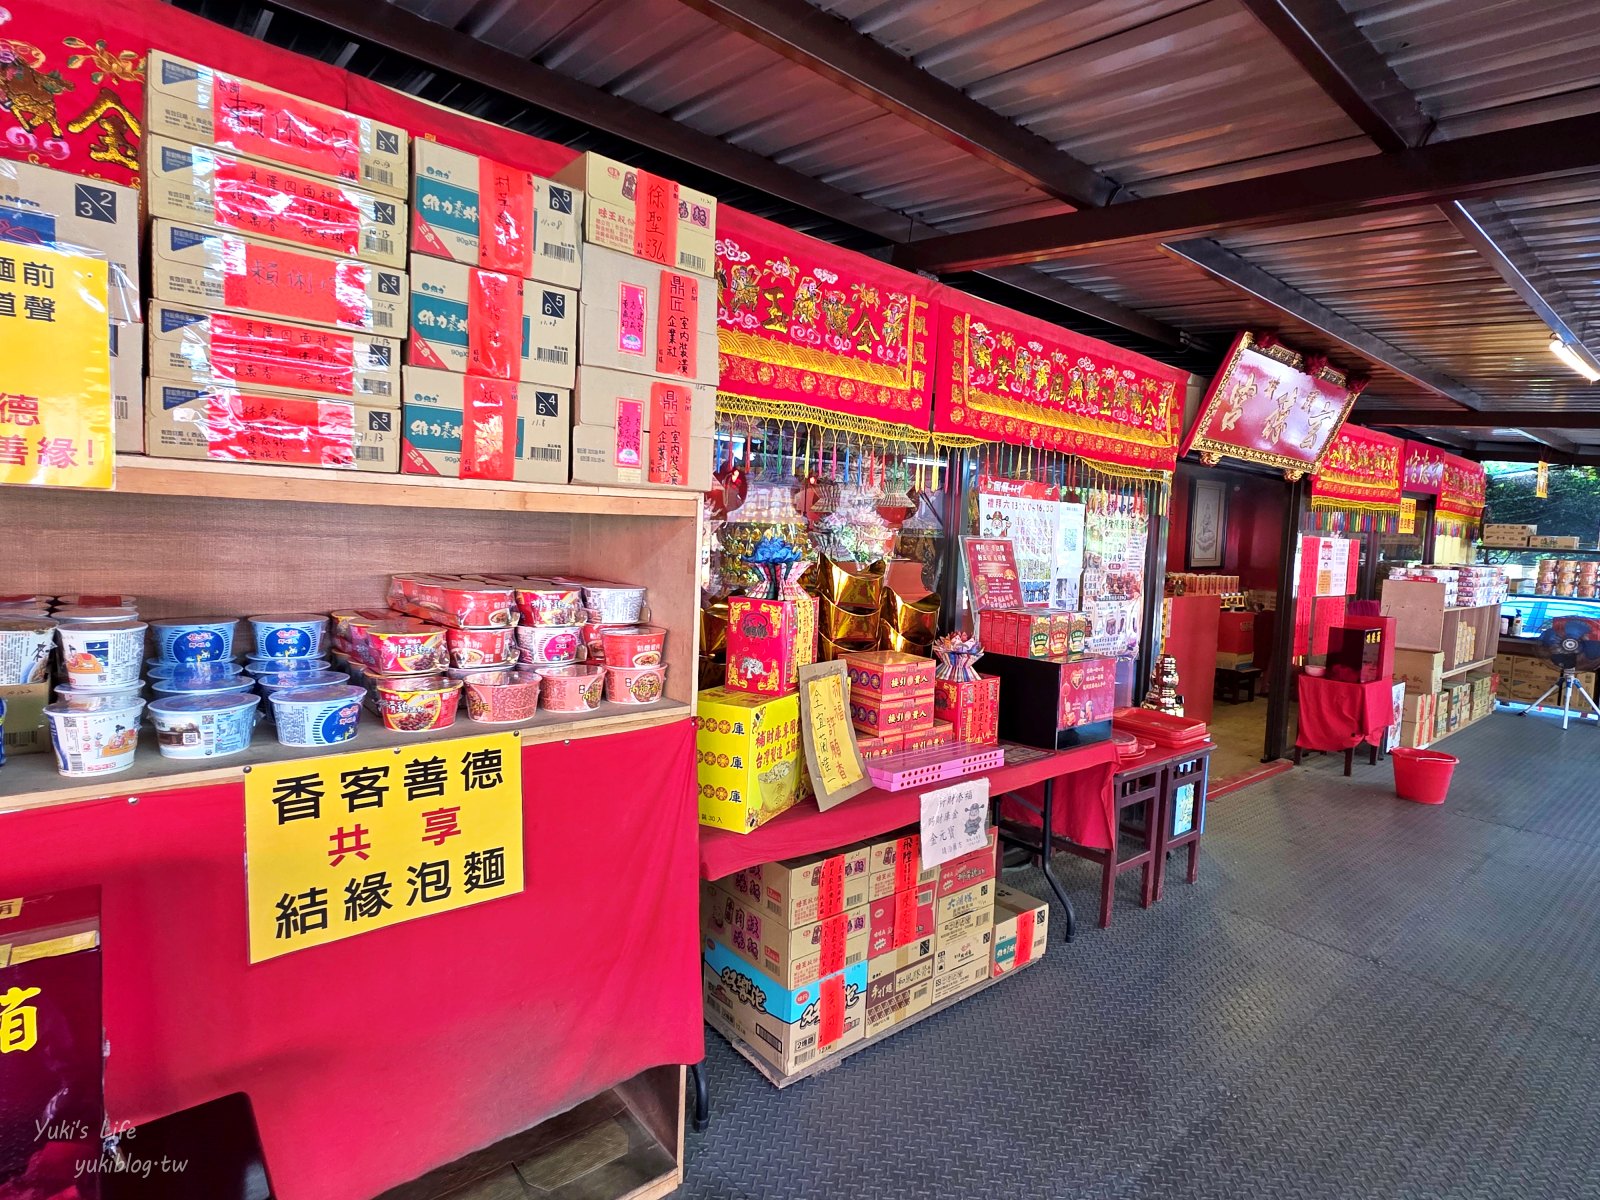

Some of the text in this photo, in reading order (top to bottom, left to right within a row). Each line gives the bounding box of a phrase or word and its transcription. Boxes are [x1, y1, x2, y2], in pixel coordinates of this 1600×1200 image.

[80, 192, 112, 216] 3 2
[552, 191, 570, 209] 6 5
[544, 295, 563, 314] 6 5
[0, 392, 40, 426] 德
[538, 395, 556, 414] 5 4
[732, 722, 745, 735] 庫
[730, 756, 743, 769] 庫
[271, 749, 504, 825] 香客善德
[729, 790, 742, 803] 庫
[327, 806, 462, 868] 共 享
[275, 847, 506, 940] 結緣泡麵
[871, 982, 893, 1000] 手打麵
